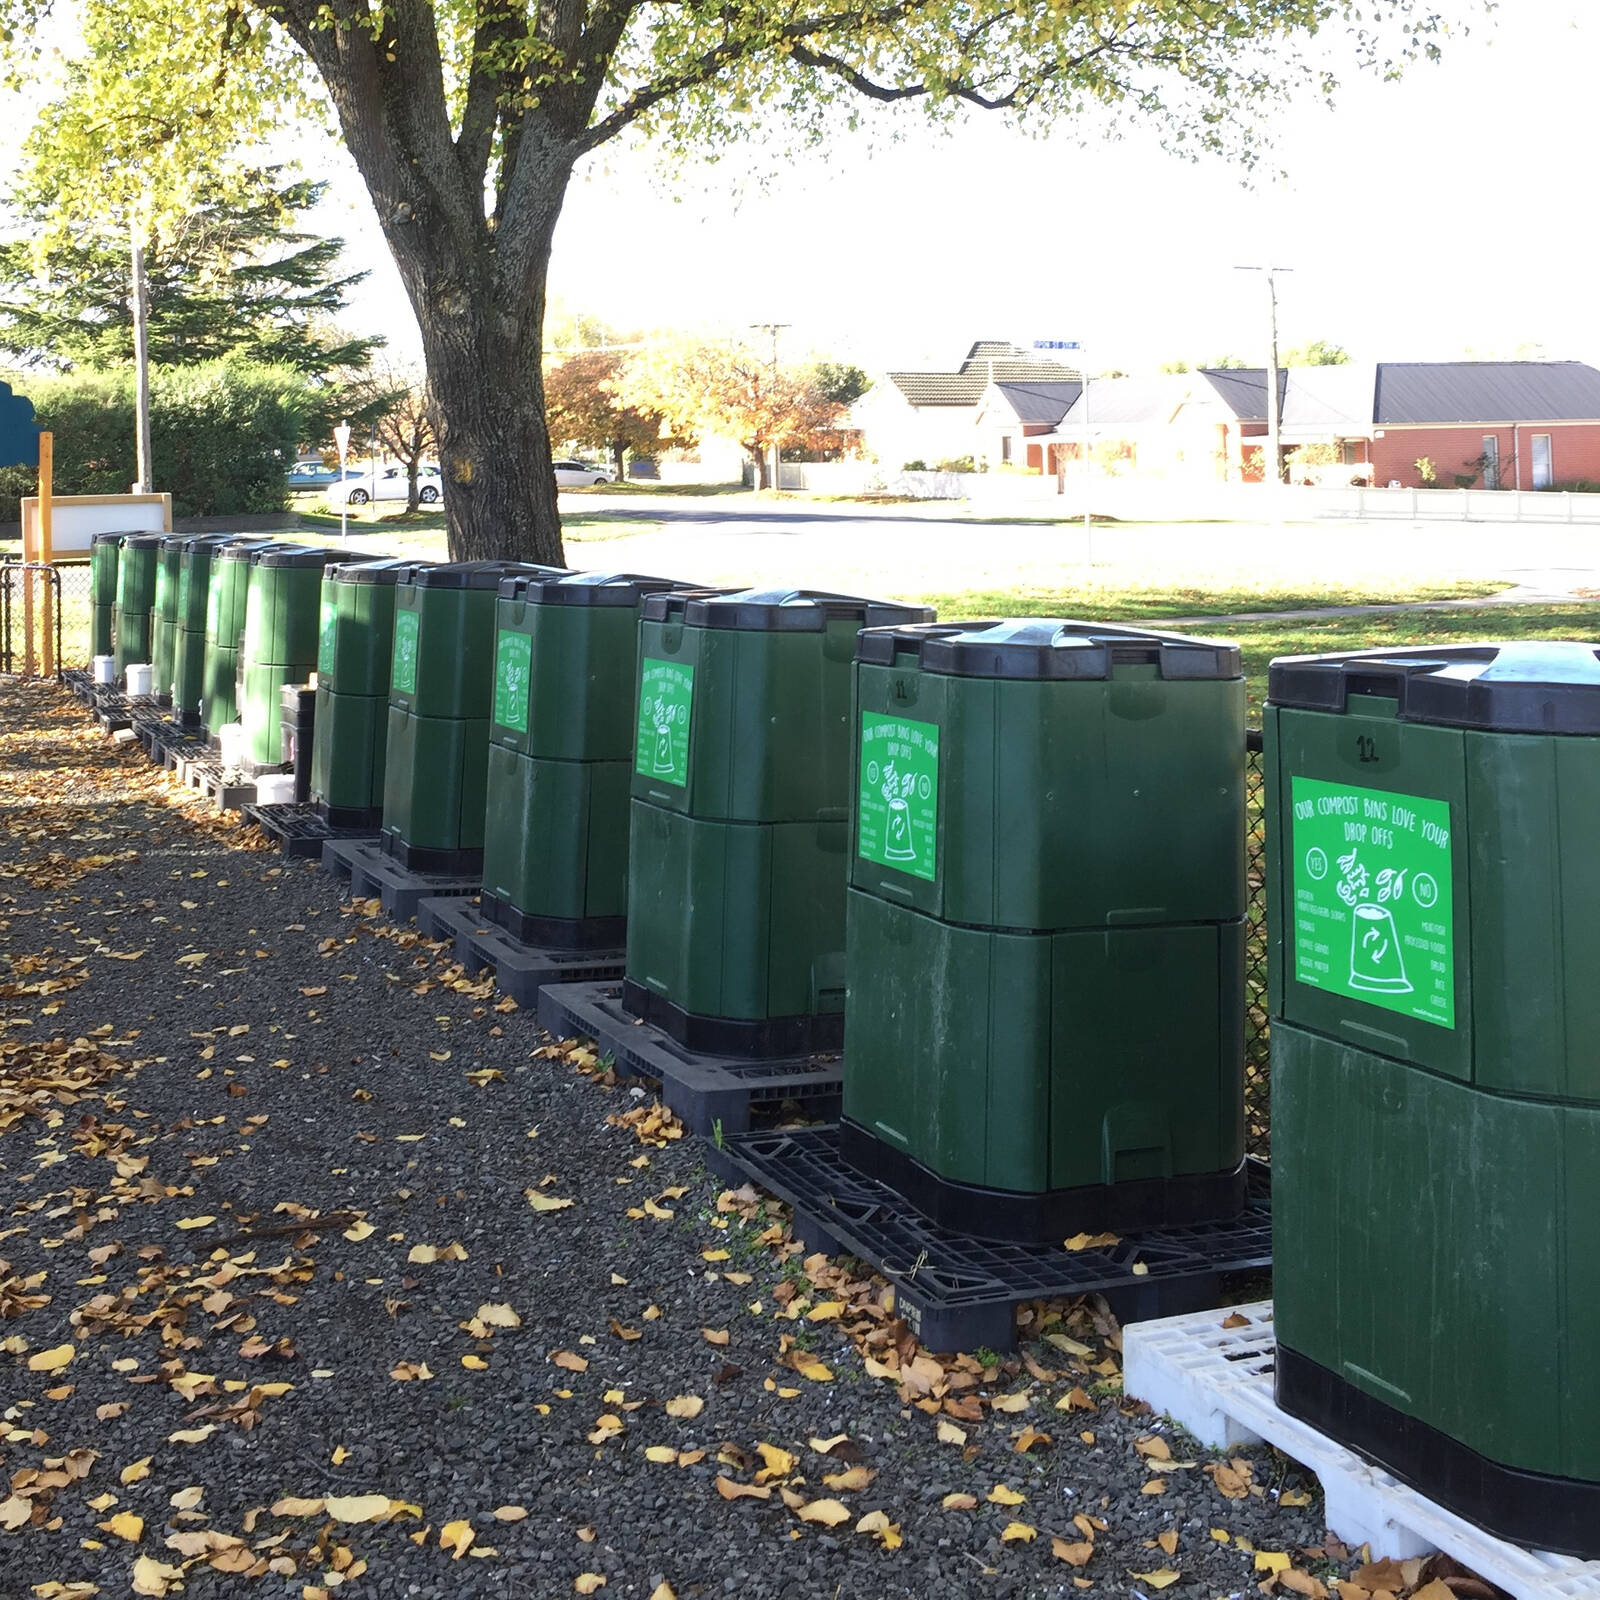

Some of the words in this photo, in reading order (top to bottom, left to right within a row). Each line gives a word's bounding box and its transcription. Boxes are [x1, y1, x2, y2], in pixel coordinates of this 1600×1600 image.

[874, 724, 896, 738] COMPOST
[897, 724, 910, 741] BINS
[911, 729, 923, 748] LOVE
[924, 738, 938, 758] YOUR
[900, 743, 912, 760] OFFS
[1295, 799, 1315, 820] OUR
[1318, 796, 1359, 816] COMPOST
[1364, 798, 1388, 821] BINS
[1392, 805, 1416, 832] LOVE
[1422, 819, 1449, 849] YOUR
[1344, 822, 1367, 843] DROP
[1371, 826, 1394, 850] OFFS
[1310, 856, 1322, 871] YES
[1419, 883, 1432, 898] NO
